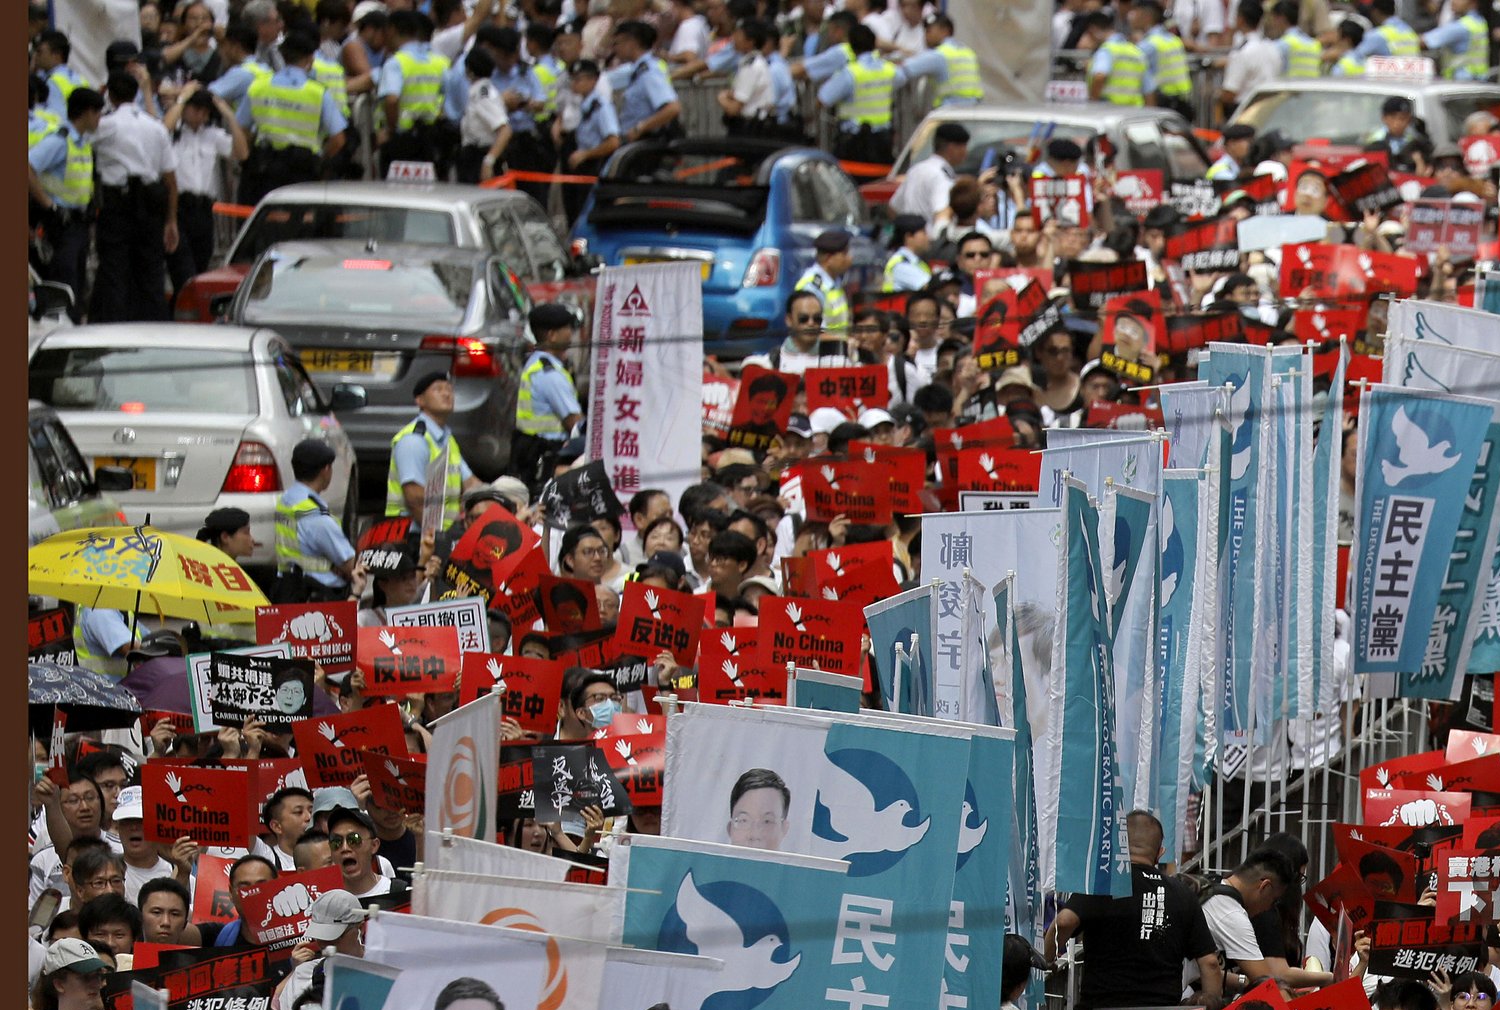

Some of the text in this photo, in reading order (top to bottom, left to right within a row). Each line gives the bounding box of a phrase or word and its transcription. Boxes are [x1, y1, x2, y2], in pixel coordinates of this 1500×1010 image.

[1371, 57, 1427, 74] TAXI
[1050, 85, 1085, 98] TAXI
[391, 163, 432, 176] TAXI
[1358, 499, 1384, 658] THE DEMOCRATIC PARTY
[1368, 499, 1425, 658] 民主黨
[630, 618, 690, 650] 反送中
[774, 632, 843, 653] No China
[374, 654, 445, 683] 反送中
[216, 686, 276, 707] 林鄭下台
[215, 711, 307, 724] CARRIE STEP DOWN!
[156, 802, 229, 825] No China
[157, 825, 230, 841] Extradition
[1100, 815, 1112, 873] PARTY
